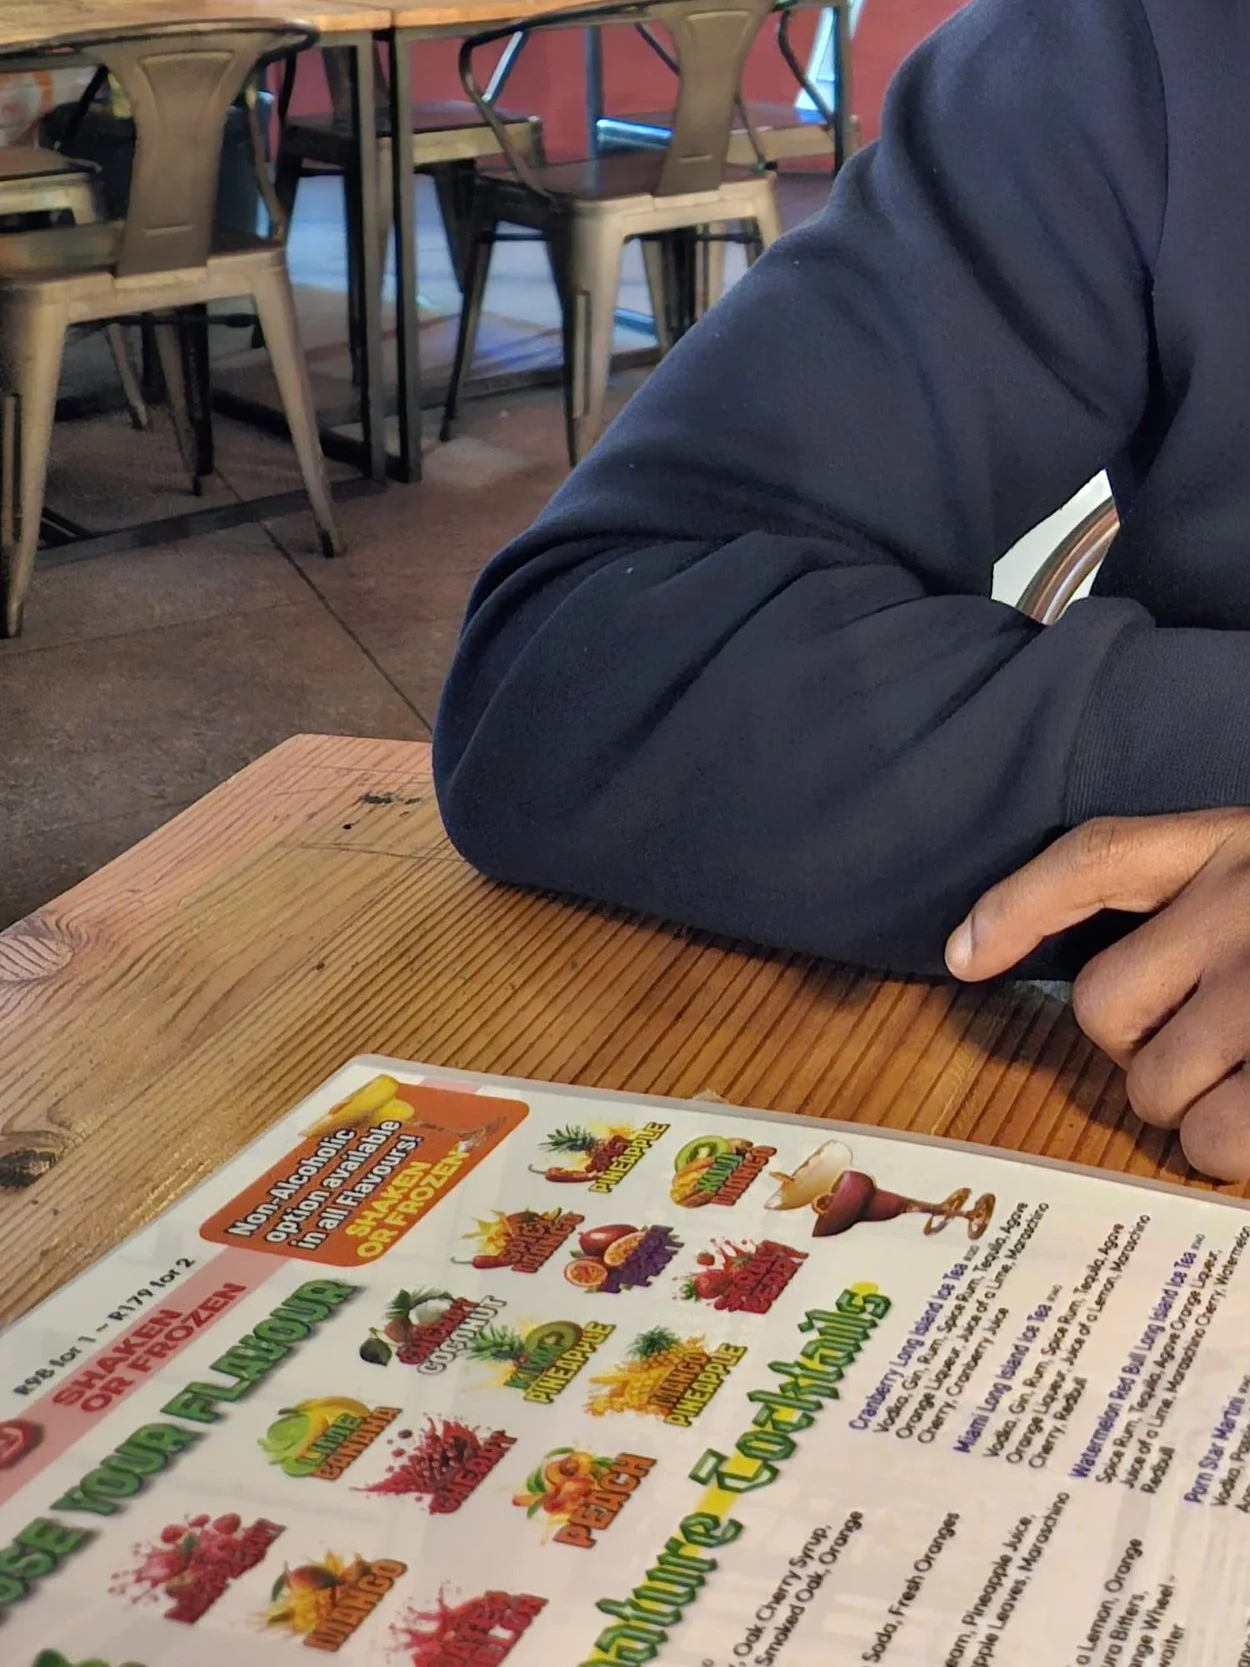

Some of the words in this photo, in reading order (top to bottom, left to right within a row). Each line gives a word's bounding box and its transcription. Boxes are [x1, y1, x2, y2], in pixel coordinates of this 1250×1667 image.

[223, 1127, 361, 1237] Non-Alcoholic
[256, 1188, 336, 1244] option
[314, 1118, 406, 1188] available
[307, 1206, 352, 1229] all
[330, 1133, 427, 1206] Flavours!
[383, 1148, 474, 1226] FROZEN
[586, 1120, 673, 1194] PINEAPPLE
[342, 1159, 434, 1237] SHAKEN
[931, 1283, 956, 1301] Ice
[942, 1263, 969, 1281] Tea
[124, 1281, 249, 1372] FROZEN
[412, 1294, 513, 1376] COCONUT
[888, 1337, 926, 1368] Long
[909, 1301, 944, 1337] Island
[1017, 1324, 1041, 1343] Ice
[1026, 1304, 1053, 1323] Tea
[46, 1307, 185, 1407] SHAKEN
[658, 1341, 754, 1428] PINEAPPLE
[995, 1343, 1031, 1381] Island
[45, 1419, 205, 1523] YOUR
[154, 1275, 367, 1425] FLAVOUR
[848, 1368, 905, 1431] Cranberry
[952, 1414, 990, 1454] Miami
[975, 1382, 1013, 1414] Long
[1211, 1396, 1246, 1441] Martini
[1183, 1472, 1214, 1504] Porn
[1197, 1441, 1225, 1471] Star
[547, 1450, 663, 1550] PEACH
[732, 1623, 766, 1658] Oak
[755, 1569, 803, 1623] Cherry
[788, 1525, 832, 1569] Syrup,
[754, 1603, 806, 1667] Smoked
[794, 1569, 832, 1603] Oak,
[817, 1511, 864, 1566] Orange
[861, 1620, 903, 1663] Soda,
[887, 1575, 925, 1617] Fresh
[913, 1512, 960, 1573] Oranges
[961, 1554, 1013, 1627] Pineapple
[1002, 1515, 1035, 1553] Juice,
[987, 1576, 1031, 1631] Leaves,
[1016, 1492, 1071, 1573] Maraschino
[1077, 1597, 1120, 1653] Lemon,
[1104, 1538, 1144, 1594] Orange
[1108, 1594, 1146, 1642] Bitters,
[1141, 1583, 1175, 1630] Wheel
